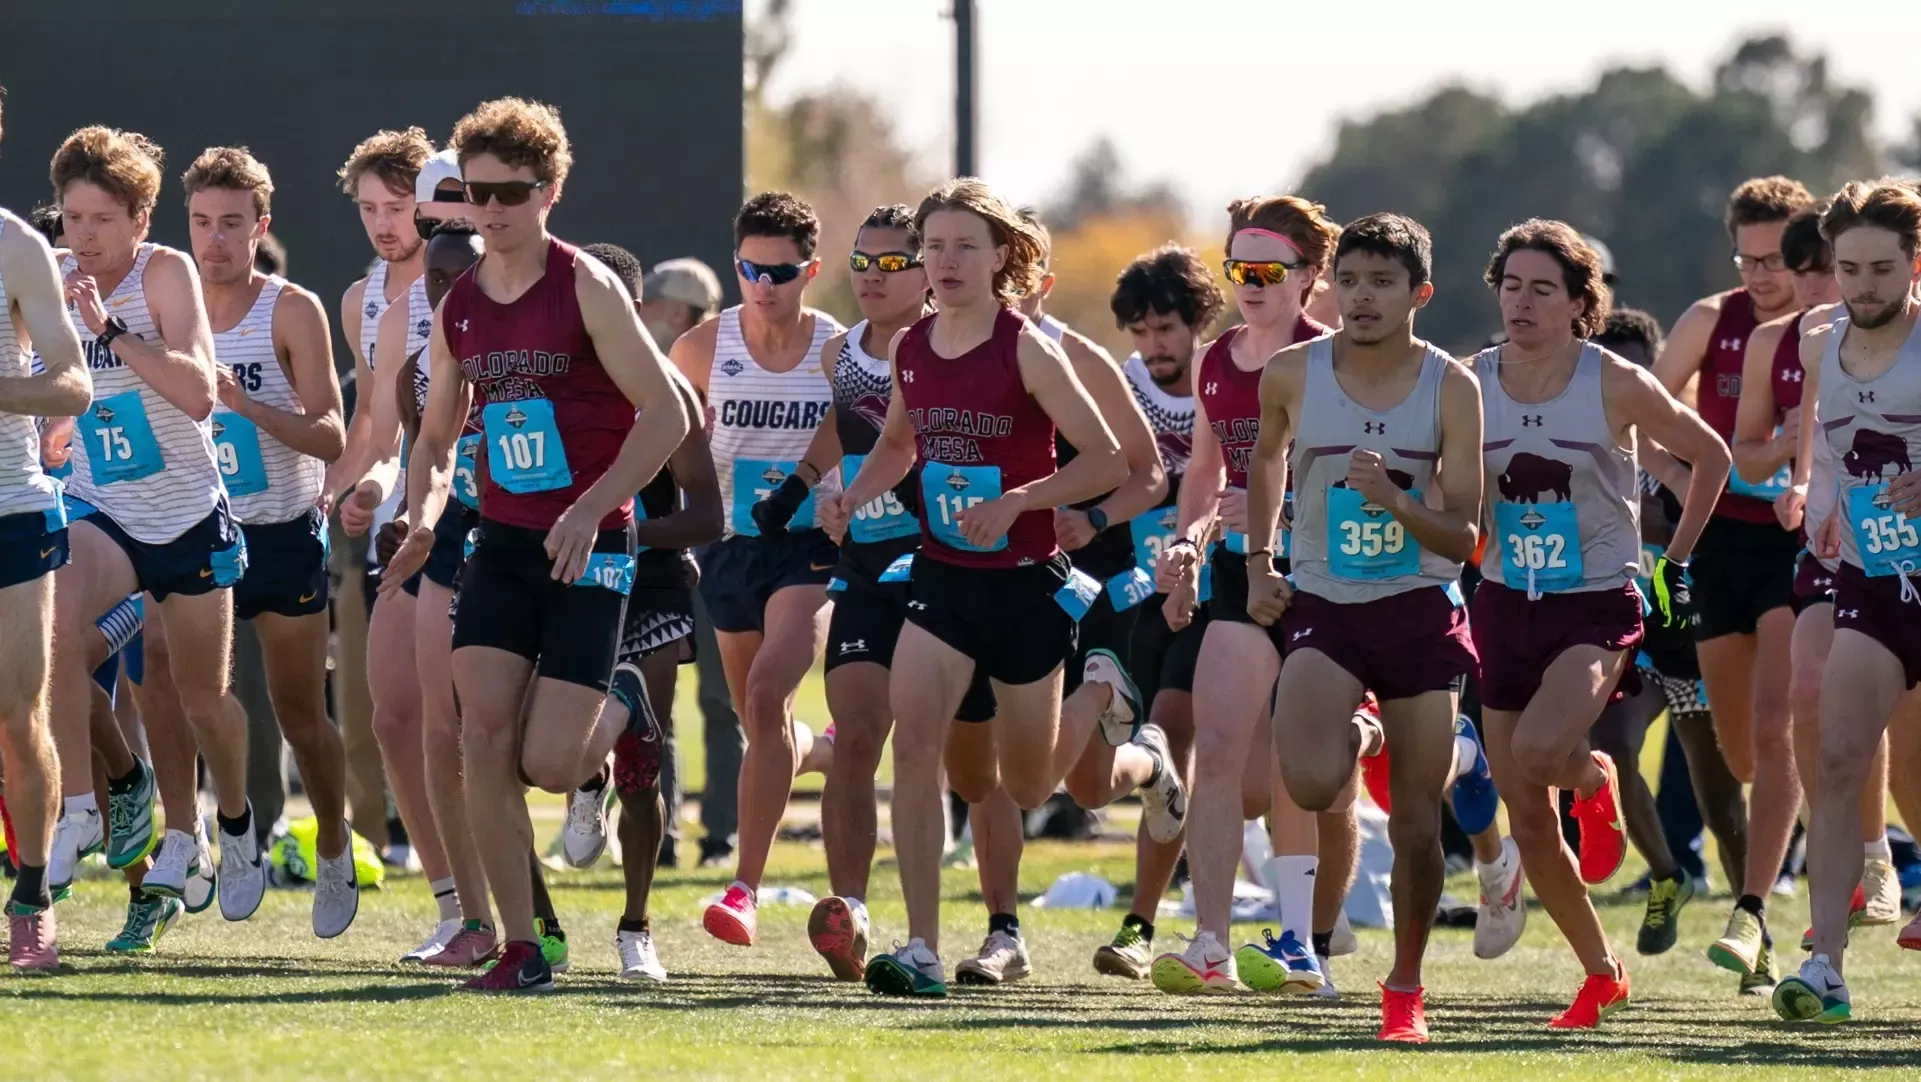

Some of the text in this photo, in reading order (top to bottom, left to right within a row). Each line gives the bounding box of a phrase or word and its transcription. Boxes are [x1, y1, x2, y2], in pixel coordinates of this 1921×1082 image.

[461, 350, 570, 383] OLORADO
[907, 407, 1013, 437] OLORADO
[95, 426, 133, 462] 75
[499, 431, 545, 470] 107
[922, 435, 984, 462] MESA
[1340, 520, 1404, 557] 359
[1861, 512, 1920, 554] 355
[1508, 533, 1567, 570] 362
[593, 566, 624, 589] 107
